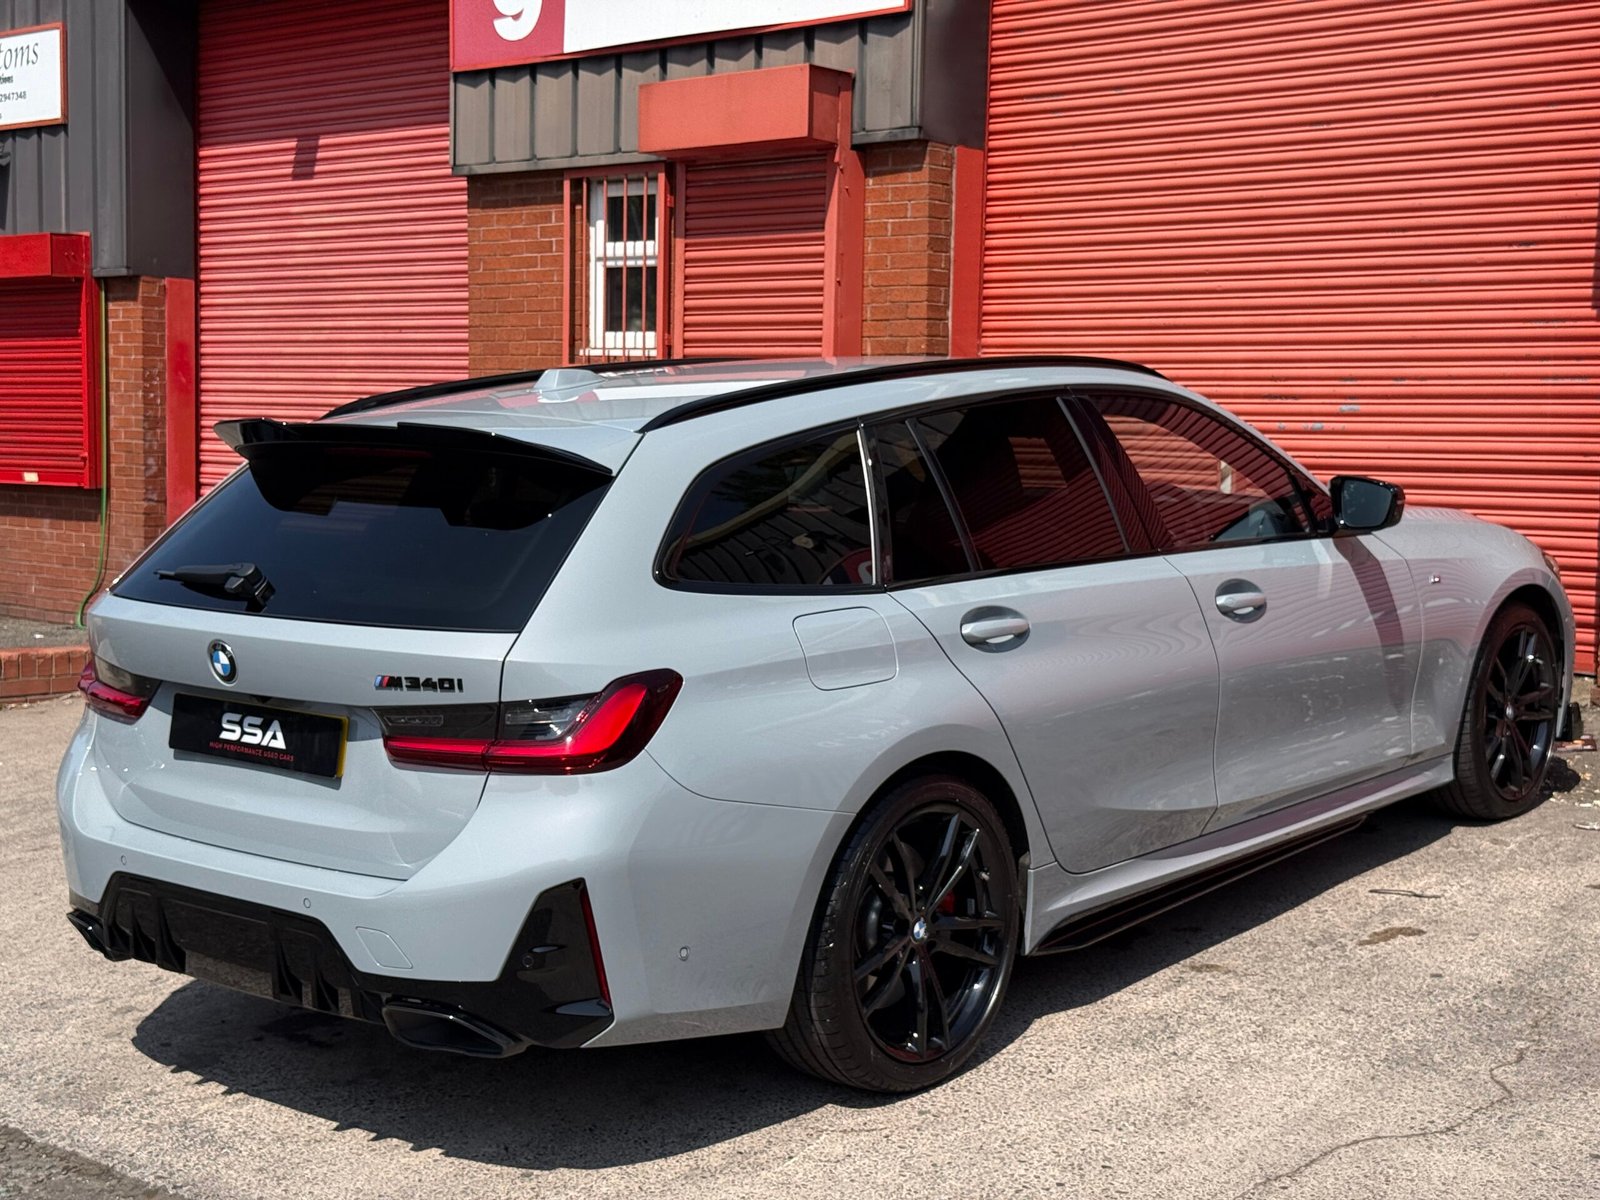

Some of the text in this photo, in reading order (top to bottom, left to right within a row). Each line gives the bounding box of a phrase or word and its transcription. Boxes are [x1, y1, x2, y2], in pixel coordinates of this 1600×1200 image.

[493, 0, 543, 42] 9
[218, 712, 287, 750] SSA
[209, 741, 294, 762] HIGH PERFORMANCE USED CARS
